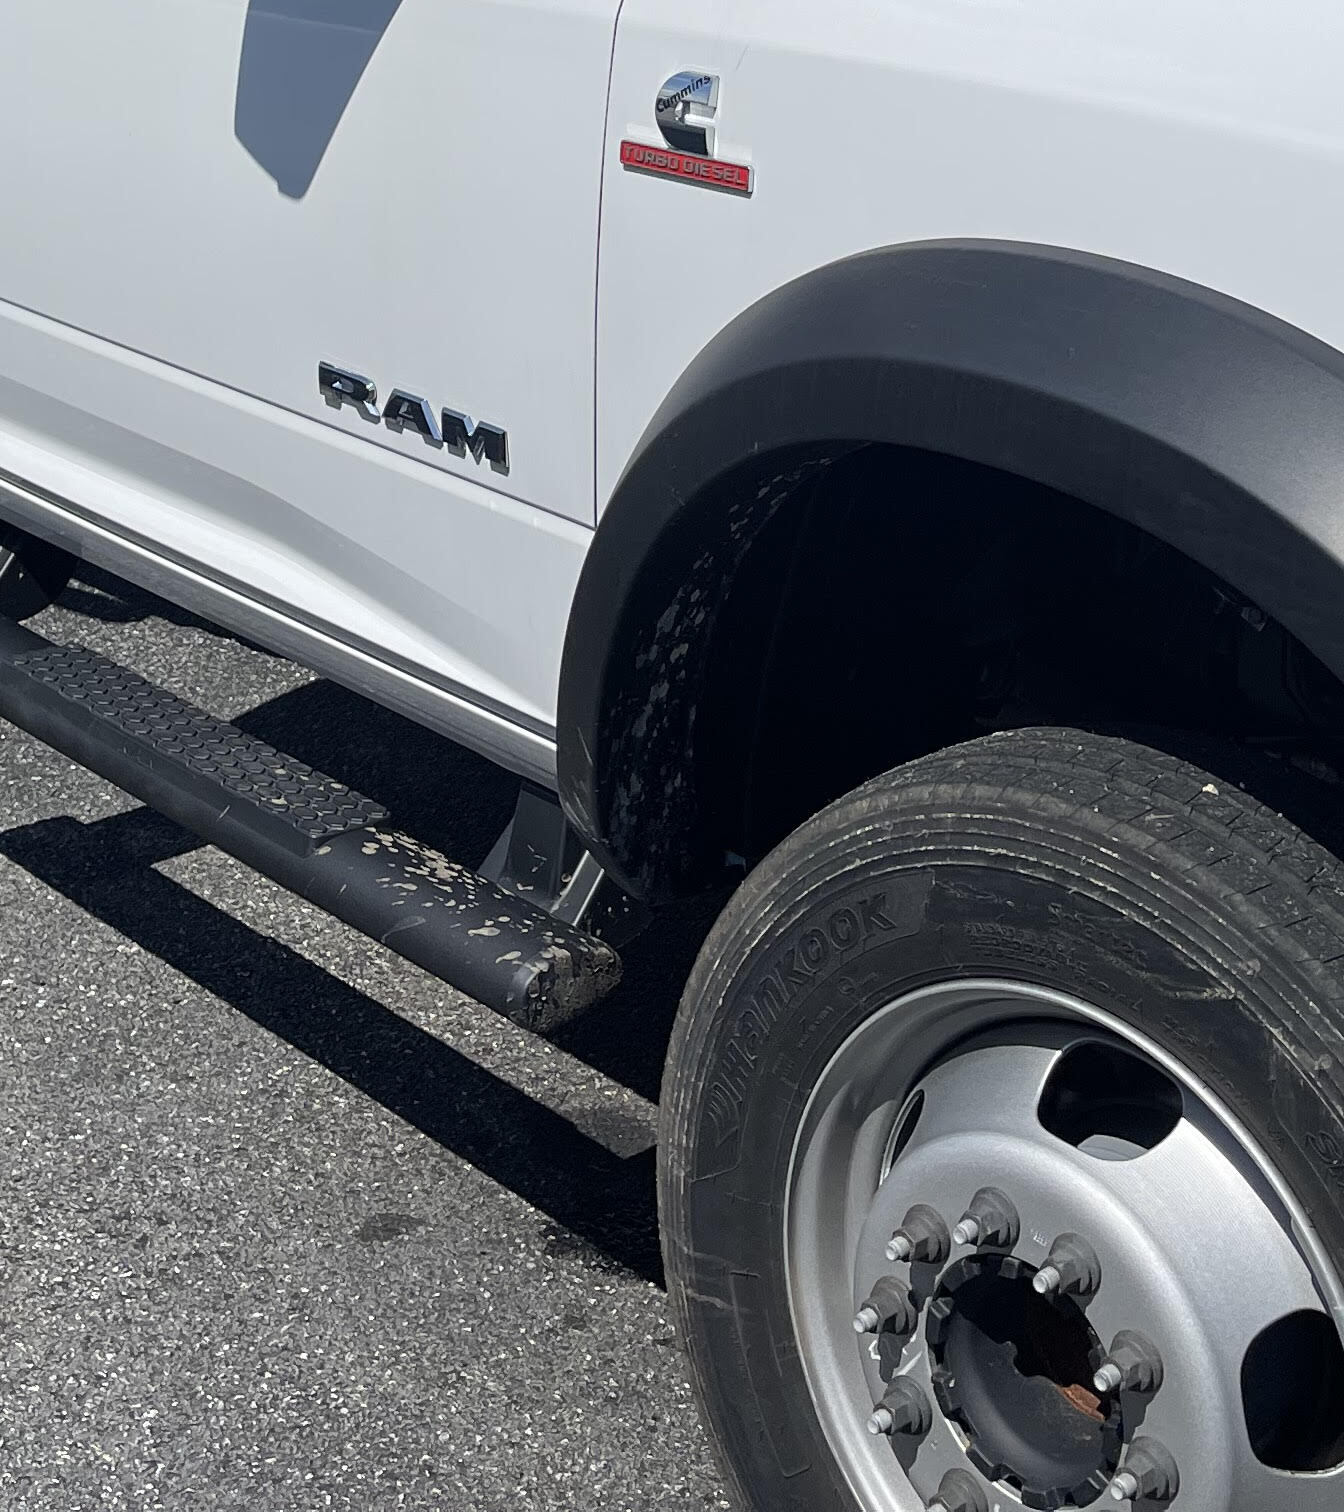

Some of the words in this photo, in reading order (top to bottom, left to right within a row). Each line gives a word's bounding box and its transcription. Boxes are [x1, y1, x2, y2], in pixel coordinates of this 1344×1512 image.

[656, 74, 712, 114] Cummins
[624, 145, 679, 170] TURBO
[682, 156, 747, 186] DIESEL
[318, 360, 510, 478] RAM
